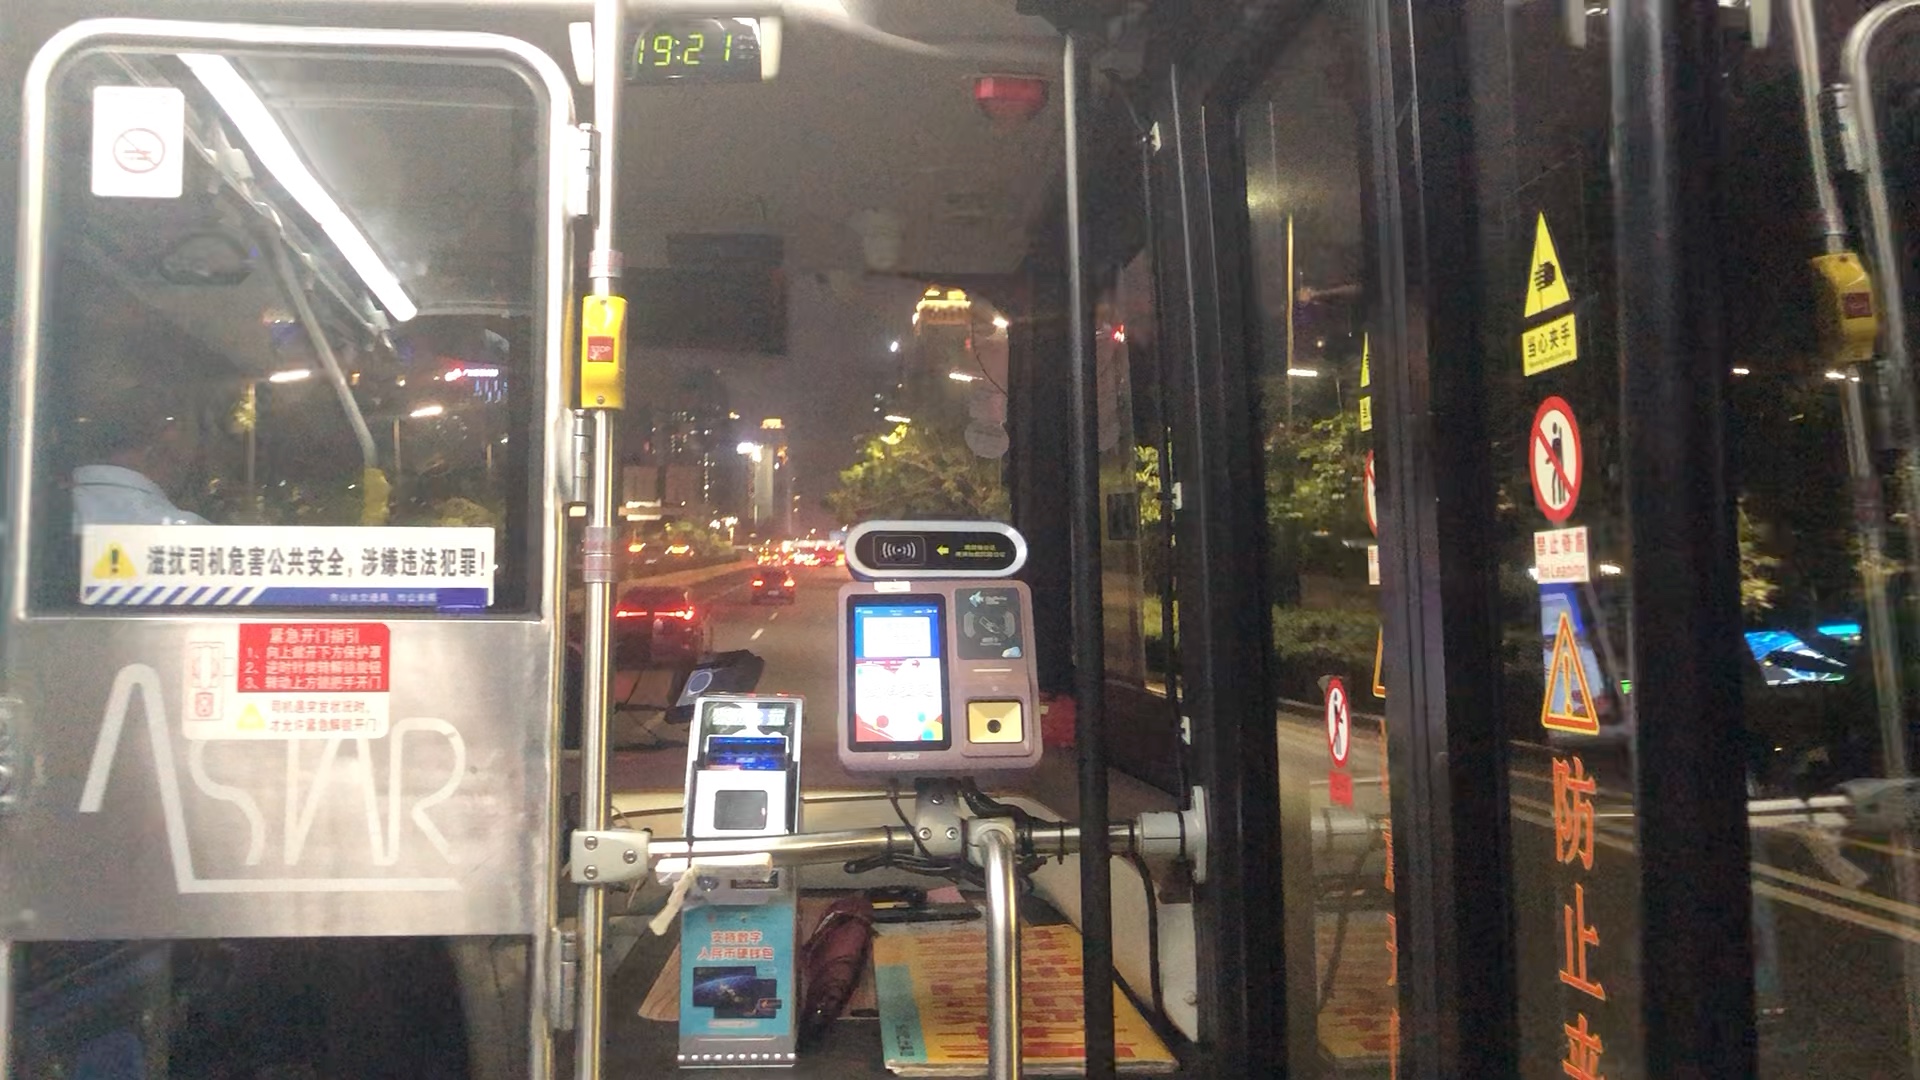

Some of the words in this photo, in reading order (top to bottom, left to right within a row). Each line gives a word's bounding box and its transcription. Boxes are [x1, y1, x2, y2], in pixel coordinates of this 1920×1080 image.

[637, 34, 733, 66] 19:21
[1527, 322, 1571, 358] 当心夹手
[269, 628, 360, 644] 紧急开门指引
